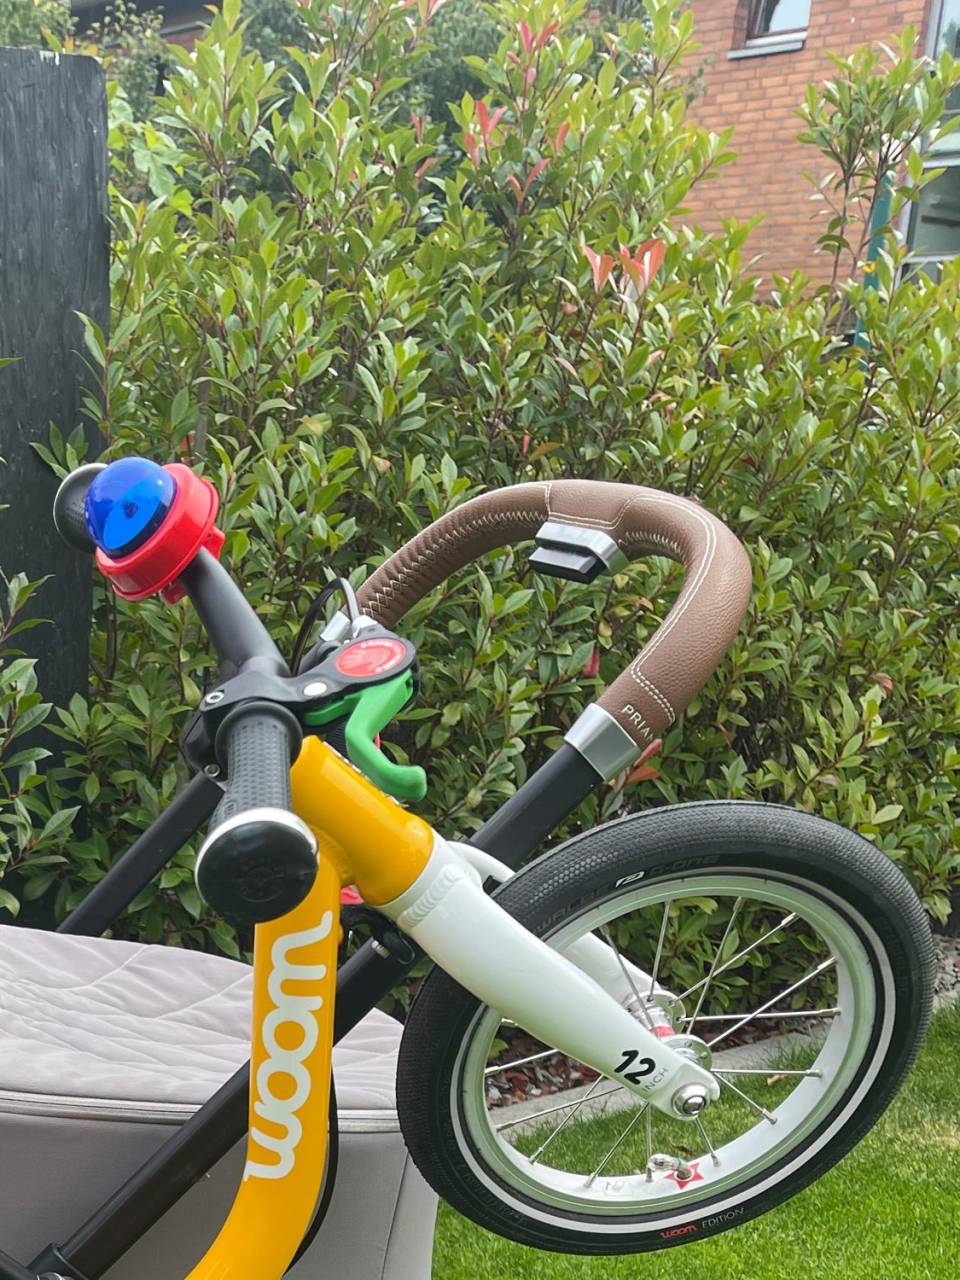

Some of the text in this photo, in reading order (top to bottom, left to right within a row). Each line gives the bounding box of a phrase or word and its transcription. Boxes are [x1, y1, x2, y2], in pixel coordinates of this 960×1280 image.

[243, 910, 333, 1181] woom
[614, 1049, 669, 1093] 12 INCH
[661, 1207, 745, 1239] woom EDITION
